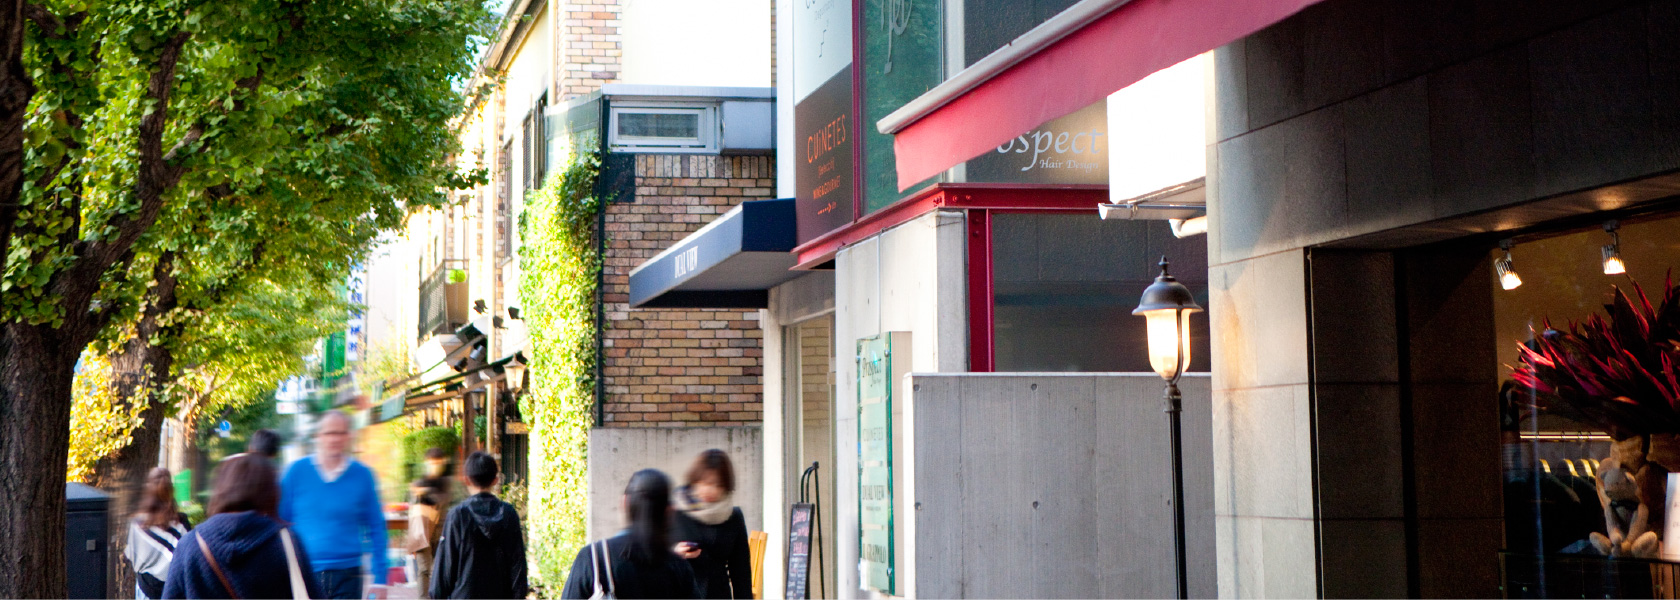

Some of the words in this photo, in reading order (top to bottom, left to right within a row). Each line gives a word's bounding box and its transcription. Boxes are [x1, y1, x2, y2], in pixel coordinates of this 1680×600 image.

[1039, 157, 1064, 169] Hair
[1067, 159, 1099, 173] Design
[674, 251, 687, 279] DUAL
[686, 245, 699, 272] VIEW
